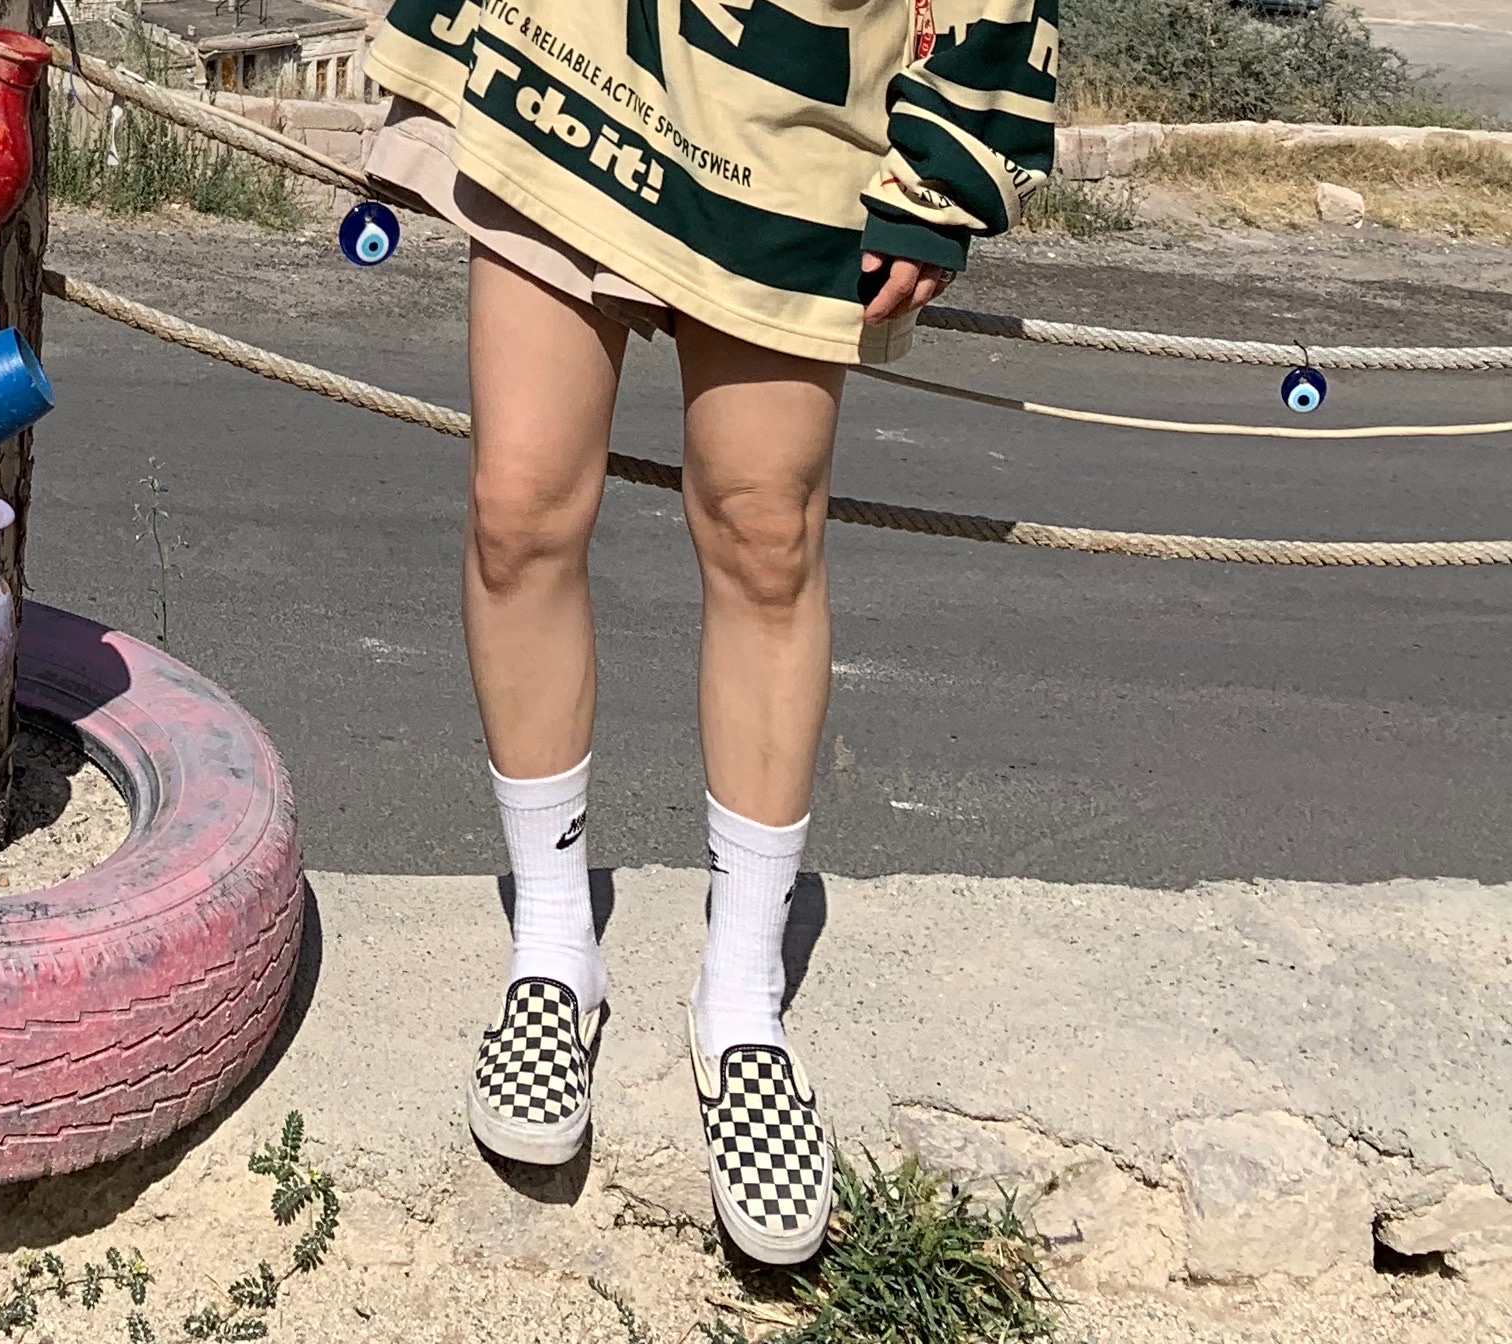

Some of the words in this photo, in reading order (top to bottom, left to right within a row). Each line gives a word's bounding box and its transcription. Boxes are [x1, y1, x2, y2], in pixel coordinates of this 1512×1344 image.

[515, 85, 592, 149] do
[589, 123, 665, 205] it!
[519, 16, 531, 37] &
[531, 24, 602, 86] RELIABLE
[601, 76, 654, 126] ACTIVE
[655, 115, 752, 188] SPORTSWEAR
